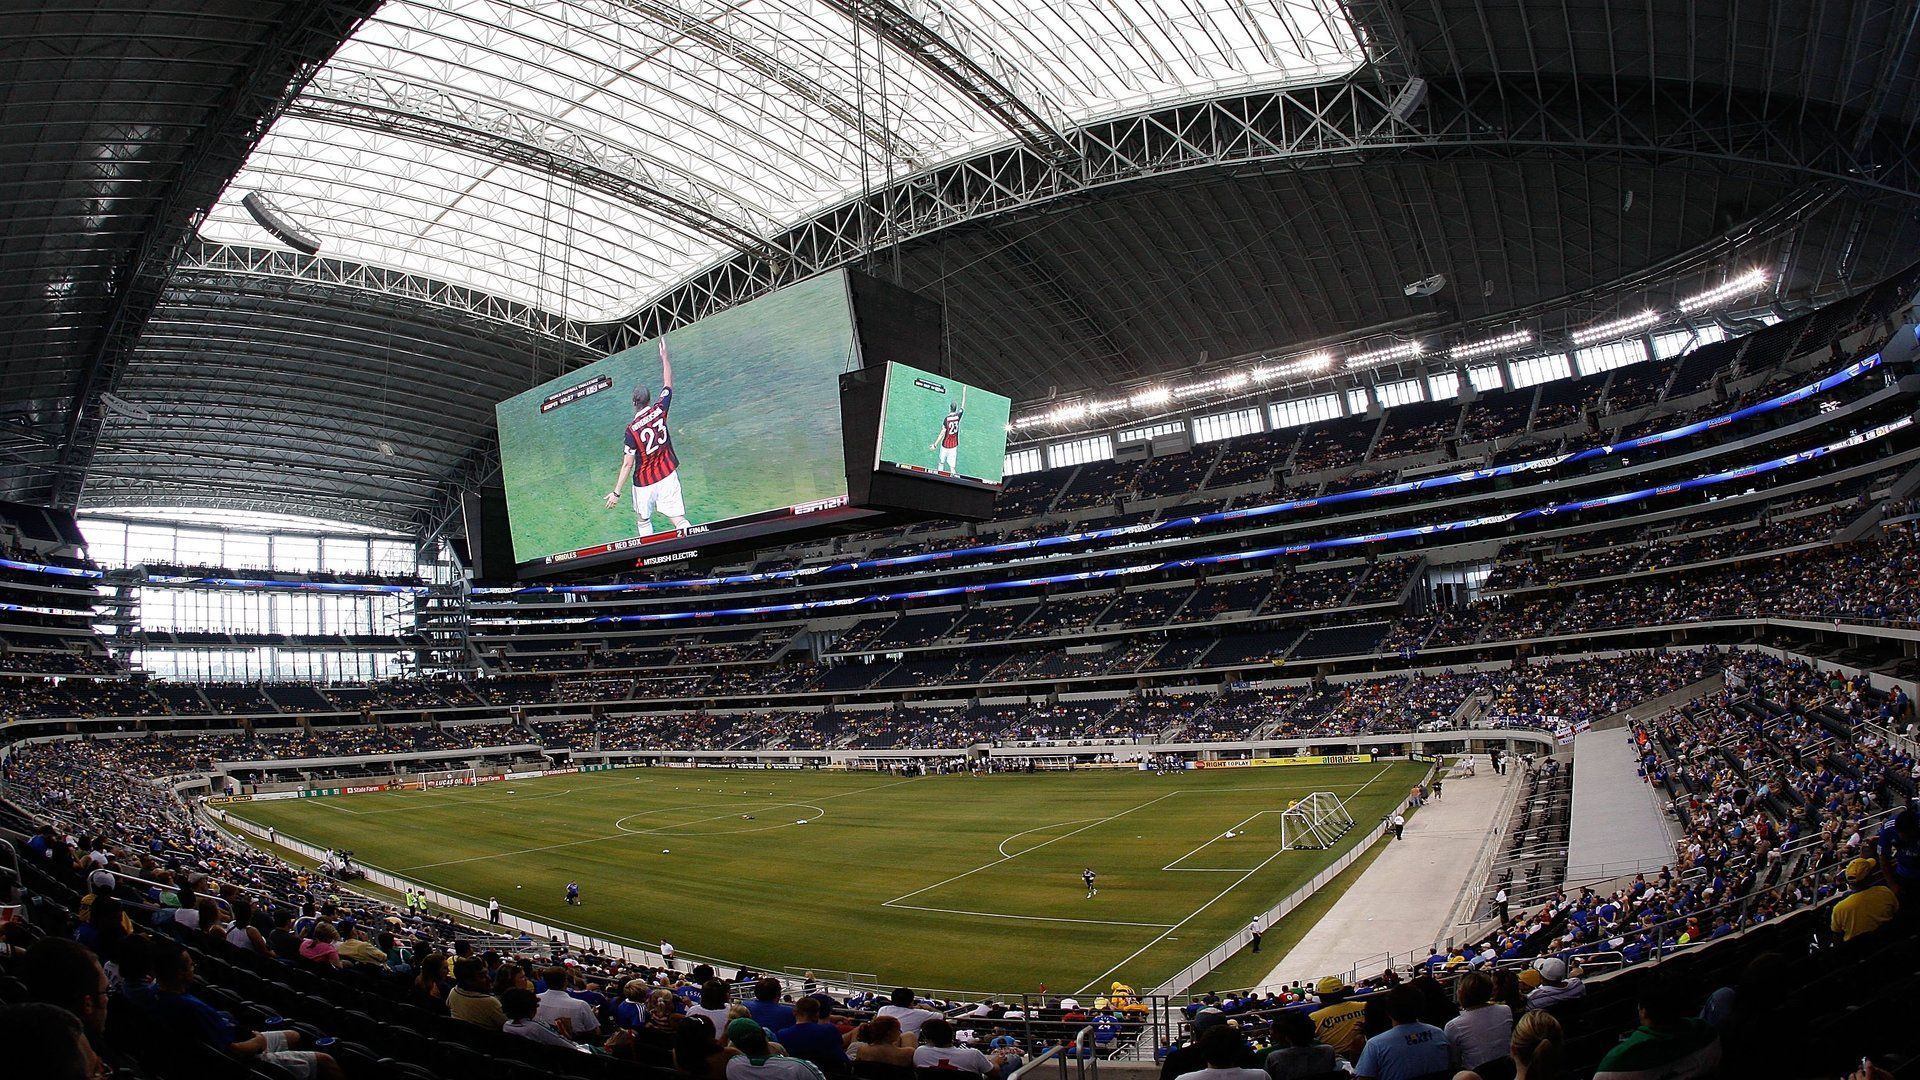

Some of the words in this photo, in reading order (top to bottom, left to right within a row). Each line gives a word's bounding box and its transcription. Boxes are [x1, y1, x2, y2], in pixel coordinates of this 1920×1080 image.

[948, 421, 958, 434] 23
[641, 418, 668, 455] 23
[1656, 484, 1680, 493] Academy
[555, 552, 577, 562] ORIOLES
[615, 540, 628, 550] RED
[628, 538, 642, 548] SOX
[689, 525, 710, 535] FINAL
[1286, 544, 1310, 552] Academy
[643, 554, 671, 566] MITSUBISHI
[672, 551, 698, 561] ELECTRIC
